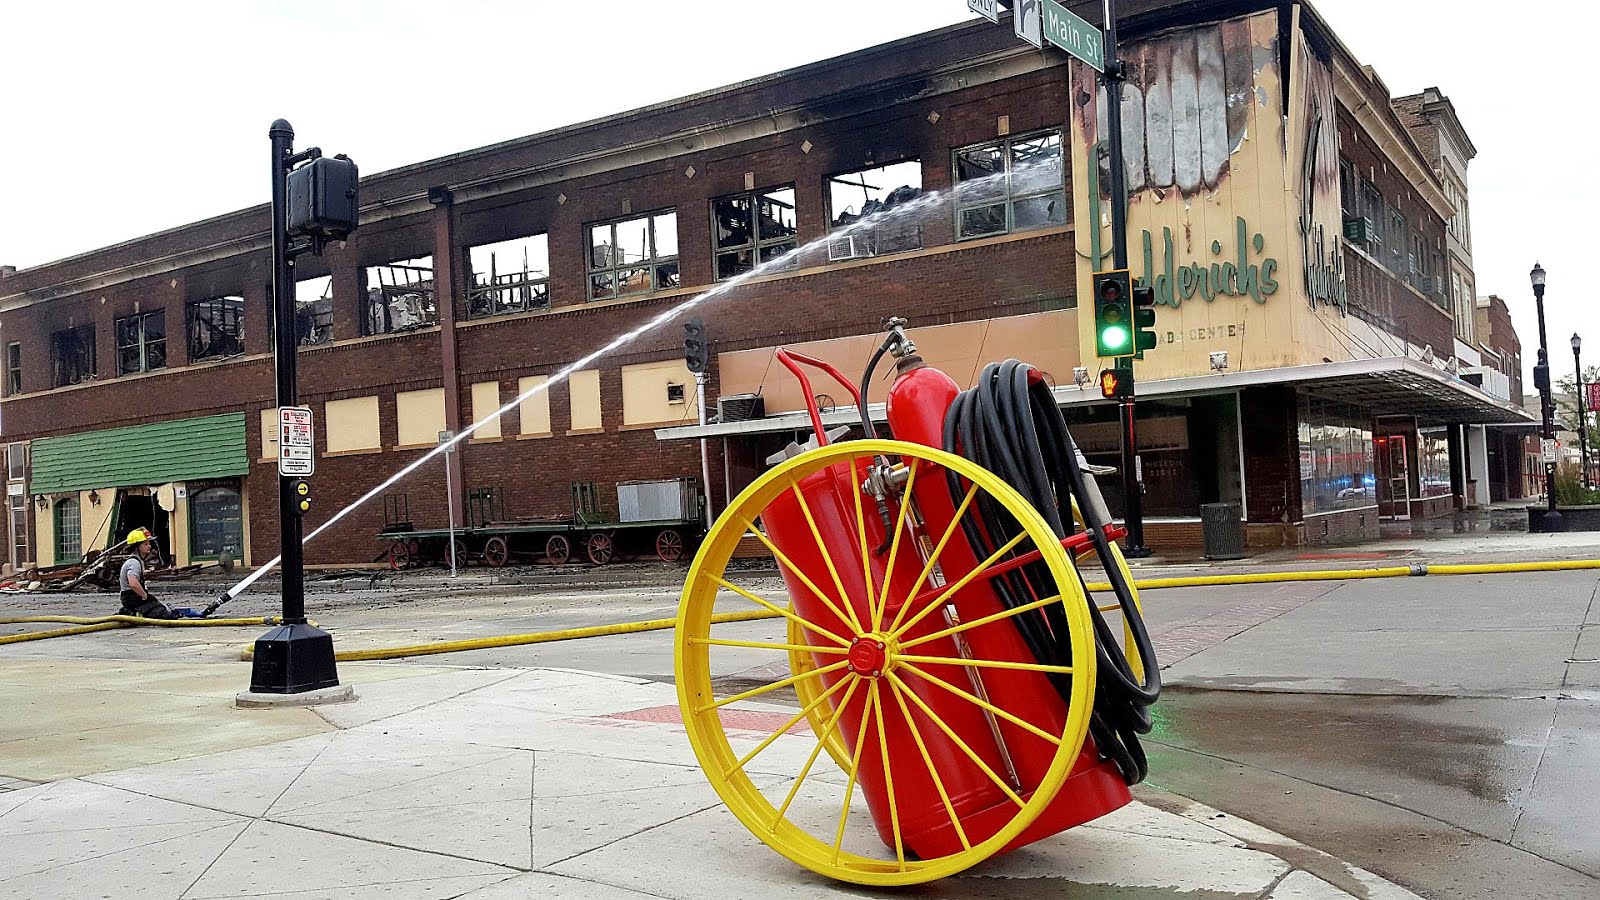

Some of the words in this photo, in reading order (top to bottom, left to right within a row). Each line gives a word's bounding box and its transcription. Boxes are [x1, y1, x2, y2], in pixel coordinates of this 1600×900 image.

[972, 0, 993, 13] NLY
[1049, 9, 1081, 50] Main
[1086, 33, 1099, 61] St
